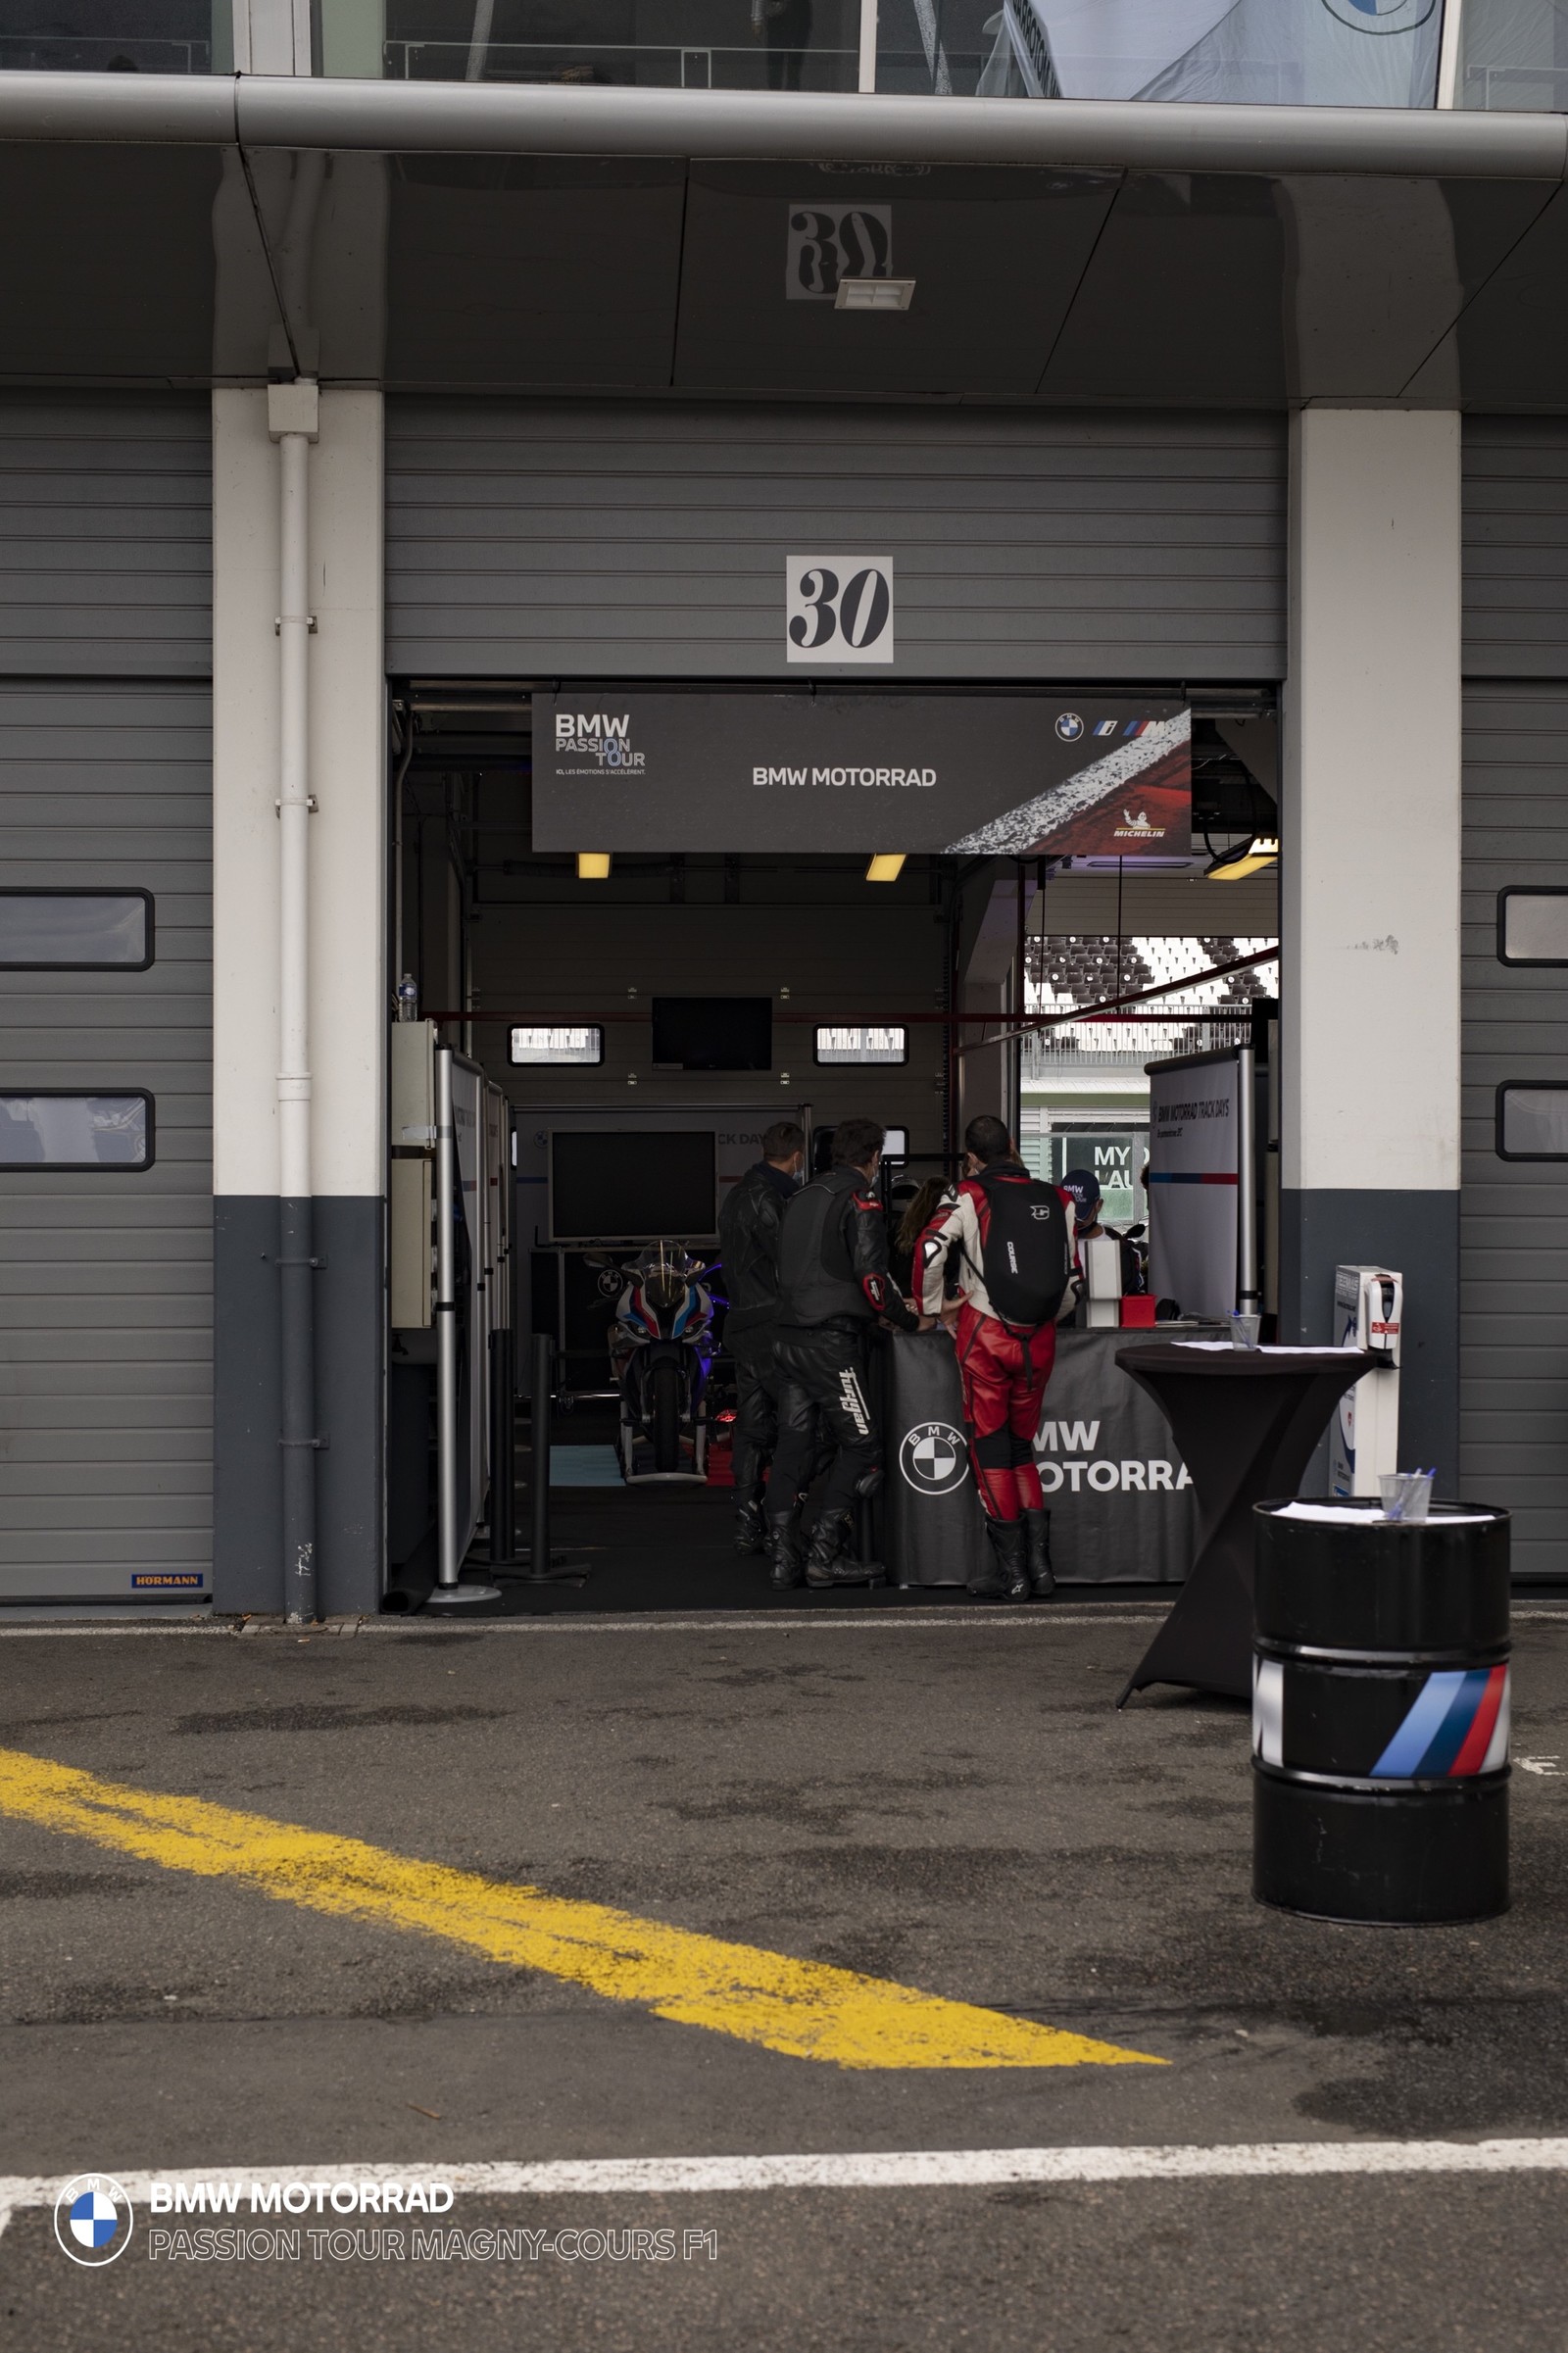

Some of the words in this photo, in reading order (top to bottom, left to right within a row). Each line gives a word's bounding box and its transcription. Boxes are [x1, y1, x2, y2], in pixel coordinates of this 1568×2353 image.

[789, 568, 890, 648] 30
[556, 714, 629, 737] BMW
[556, 738, 630, 753] PASSION
[595, 752, 645, 767] TOUR
[753, 767, 808, 787] BMW
[811, 767, 937, 787] MOTORRAD
[1198, 1100, 1215, 1119] TRACK
[1215, 1099, 1229, 1117] DAYS
[1095, 1146, 1131, 1165] MY
[1006, 1241, 1018, 1274] COURSE
[1034, 1421, 1101, 1451] MW
[1039, 1460, 1194, 1493] OTORRA
